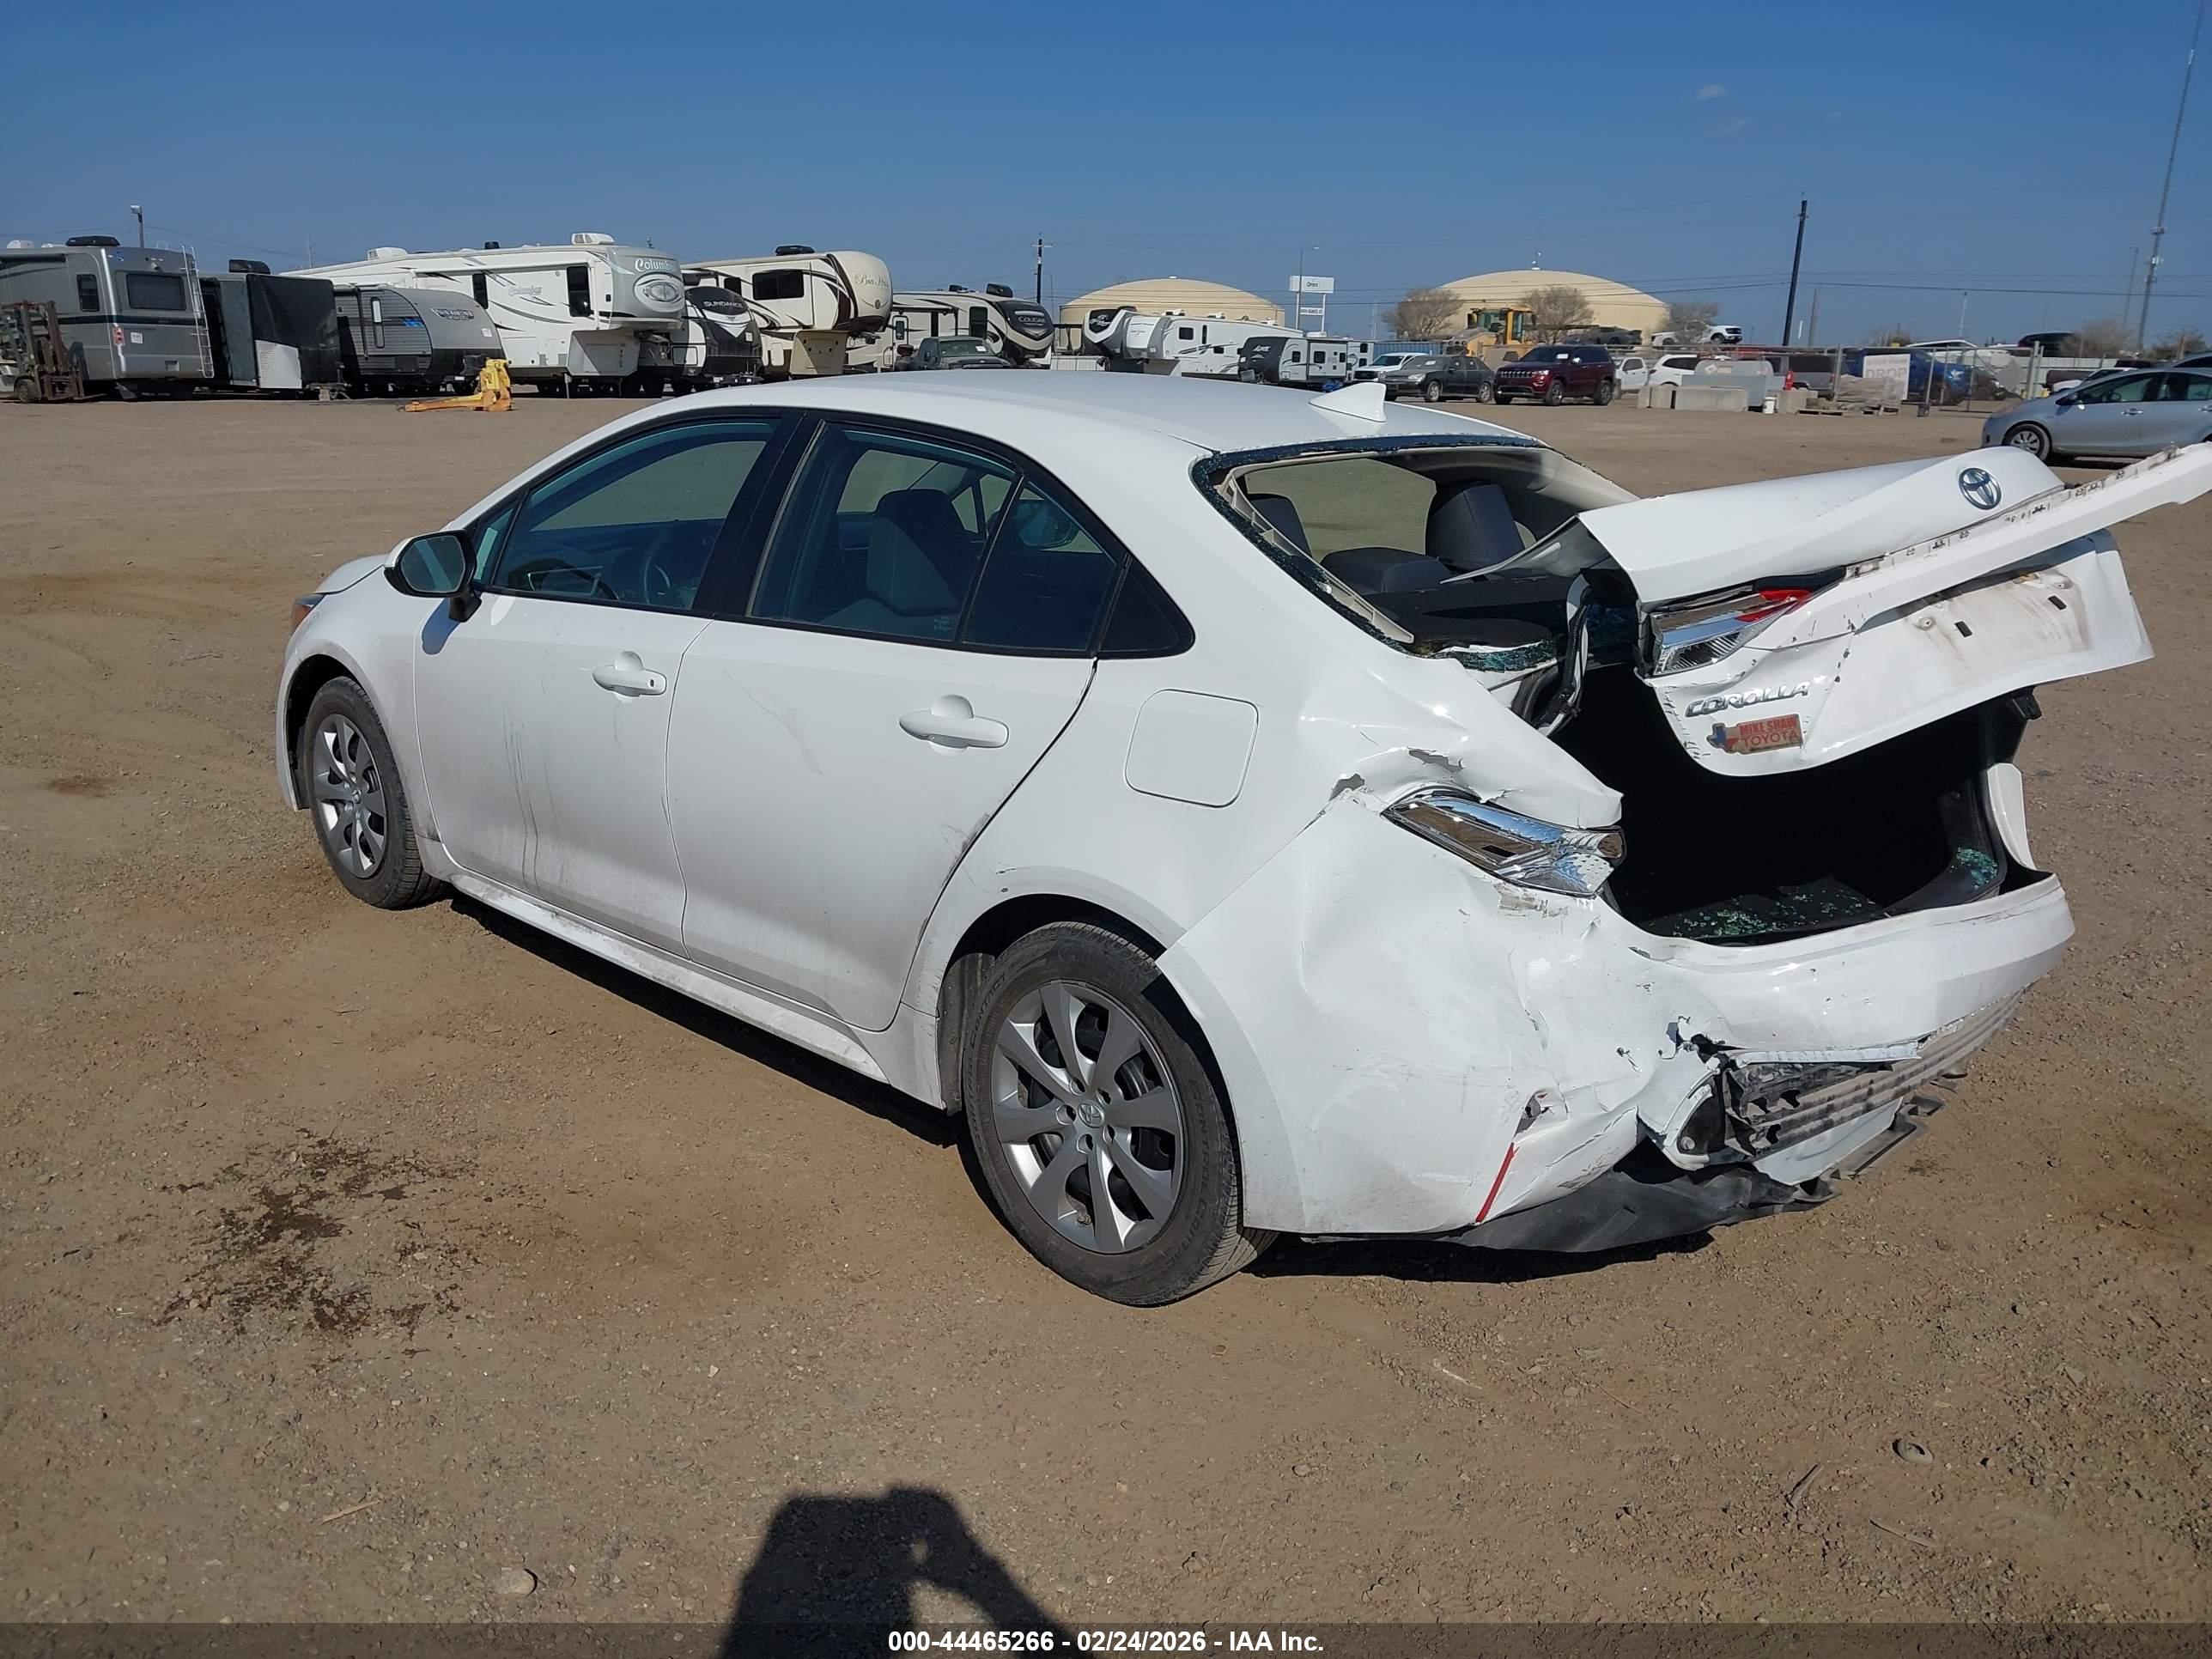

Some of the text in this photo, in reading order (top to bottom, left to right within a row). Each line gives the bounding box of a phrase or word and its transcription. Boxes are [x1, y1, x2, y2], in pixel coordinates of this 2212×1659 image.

[1866, 368, 1908, 379] DROP
[1685, 681, 1811, 718] COROLLA
[1739, 716, 1798, 736] MIKE SHAW
[1742, 730, 1799, 747] TOYOTA
